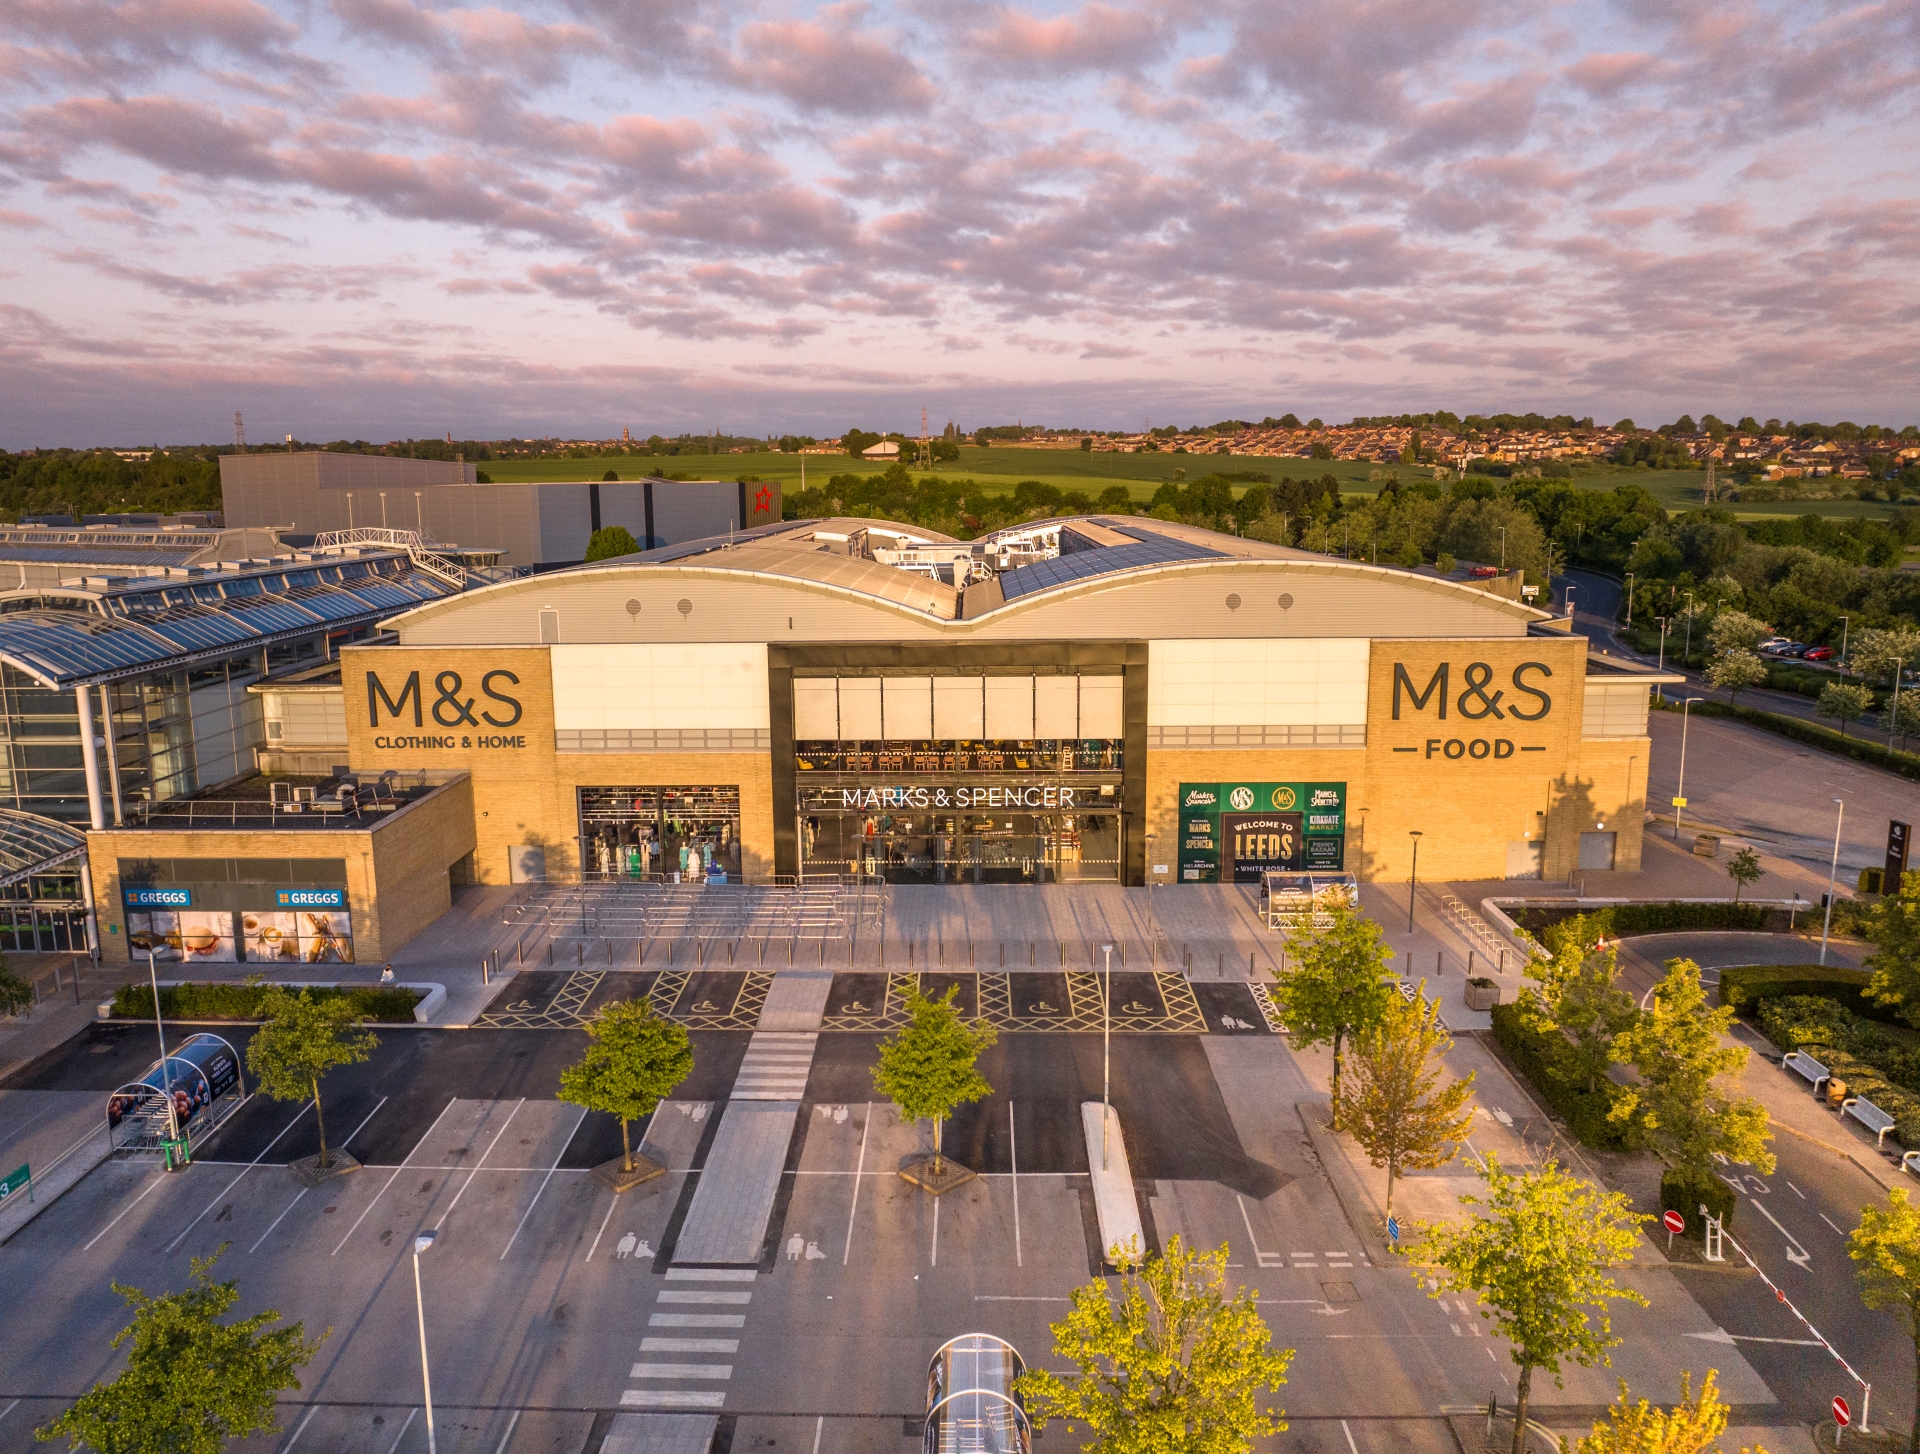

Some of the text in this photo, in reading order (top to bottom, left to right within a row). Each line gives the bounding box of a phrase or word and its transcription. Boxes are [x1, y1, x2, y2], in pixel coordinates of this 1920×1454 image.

[1392, 662, 1553, 721] M&S
[366, 670, 523, 728] M&S
[375, 736, 526, 749] CLOTHING & HOME
[1426, 739, 1515, 760] FOOD
[843, 787, 1075, 808] MARKS & SPENCER
[1309, 815, 1339, 824] KIRKGATE
[1189, 823, 1211, 832] MARKS
[1234, 821, 1293, 831] WELCOME TO
[1186, 840, 1213, 849] SPENCER
[1235, 834, 1292, 860] LEEDS
[140, 893, 187, 903] GREGGS
[292, 893, 339, 904] GREGGS
